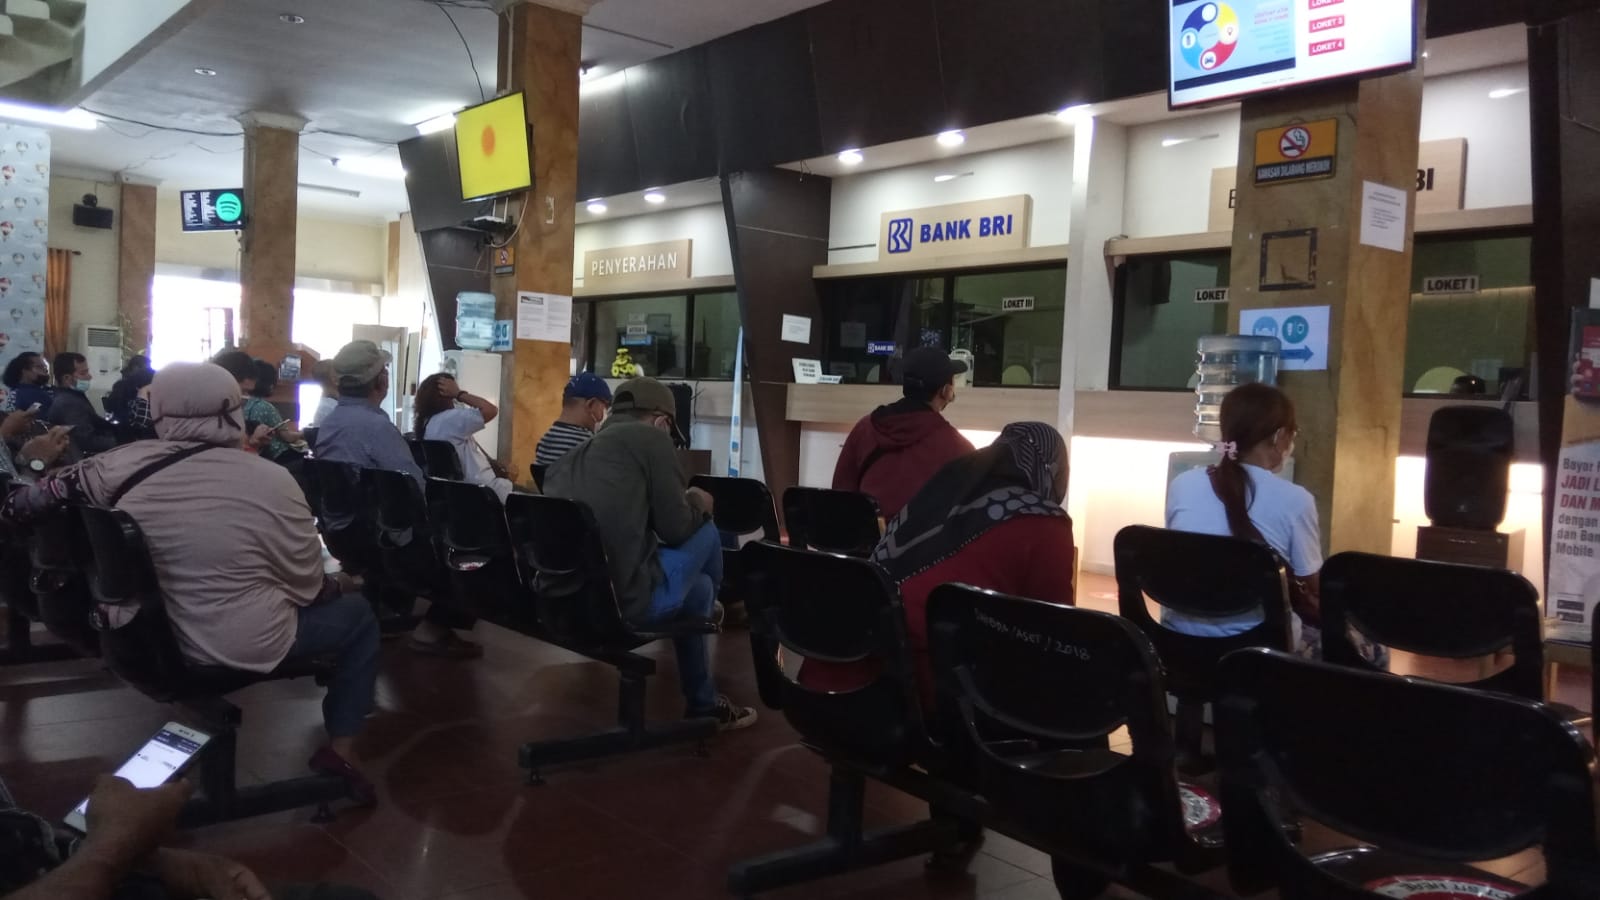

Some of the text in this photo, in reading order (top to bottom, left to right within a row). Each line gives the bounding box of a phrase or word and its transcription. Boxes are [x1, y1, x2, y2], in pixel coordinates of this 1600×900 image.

[1311, 18, 1337, 30] LOKET
[1311, 41, 1337, 53] LOKET
[920, 214, 1013, 243] BANK BRI
[591, 251, 677, 276] PENYERAHAN
[1427, 278, 1468, 291] LOKET
[1196, 290, 1226, 301] LOKET
[1003, 299, 1024, 309] LOKET
[1563, 458, 1593, 473] Bayar
[1561, 475, 1590, 491] JADI
[1560, 494, 1587, 510] DAN
[1558, 513, 1598, 529] dengan
[1557, 528, 1576, 540] dan
[1556, 542, 1594, 558] Mobile
